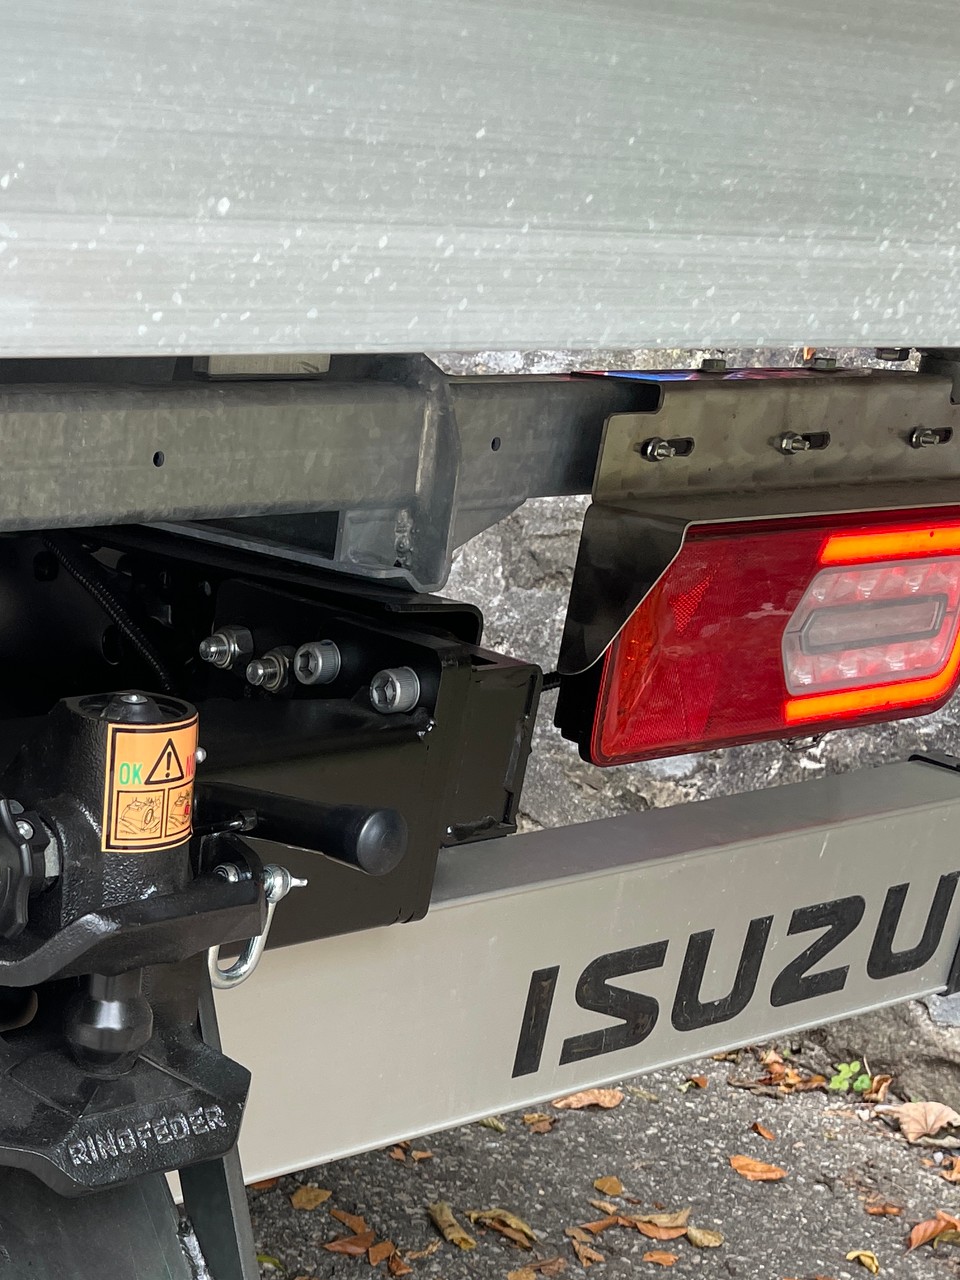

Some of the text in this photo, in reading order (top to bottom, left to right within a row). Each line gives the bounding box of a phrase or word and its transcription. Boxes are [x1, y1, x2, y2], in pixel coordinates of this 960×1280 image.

[119, 762, 143, 785] OK
[511, 869, 960, 1079] ISUZU
[68, 1104, 228, 1167] RINGFEDER
